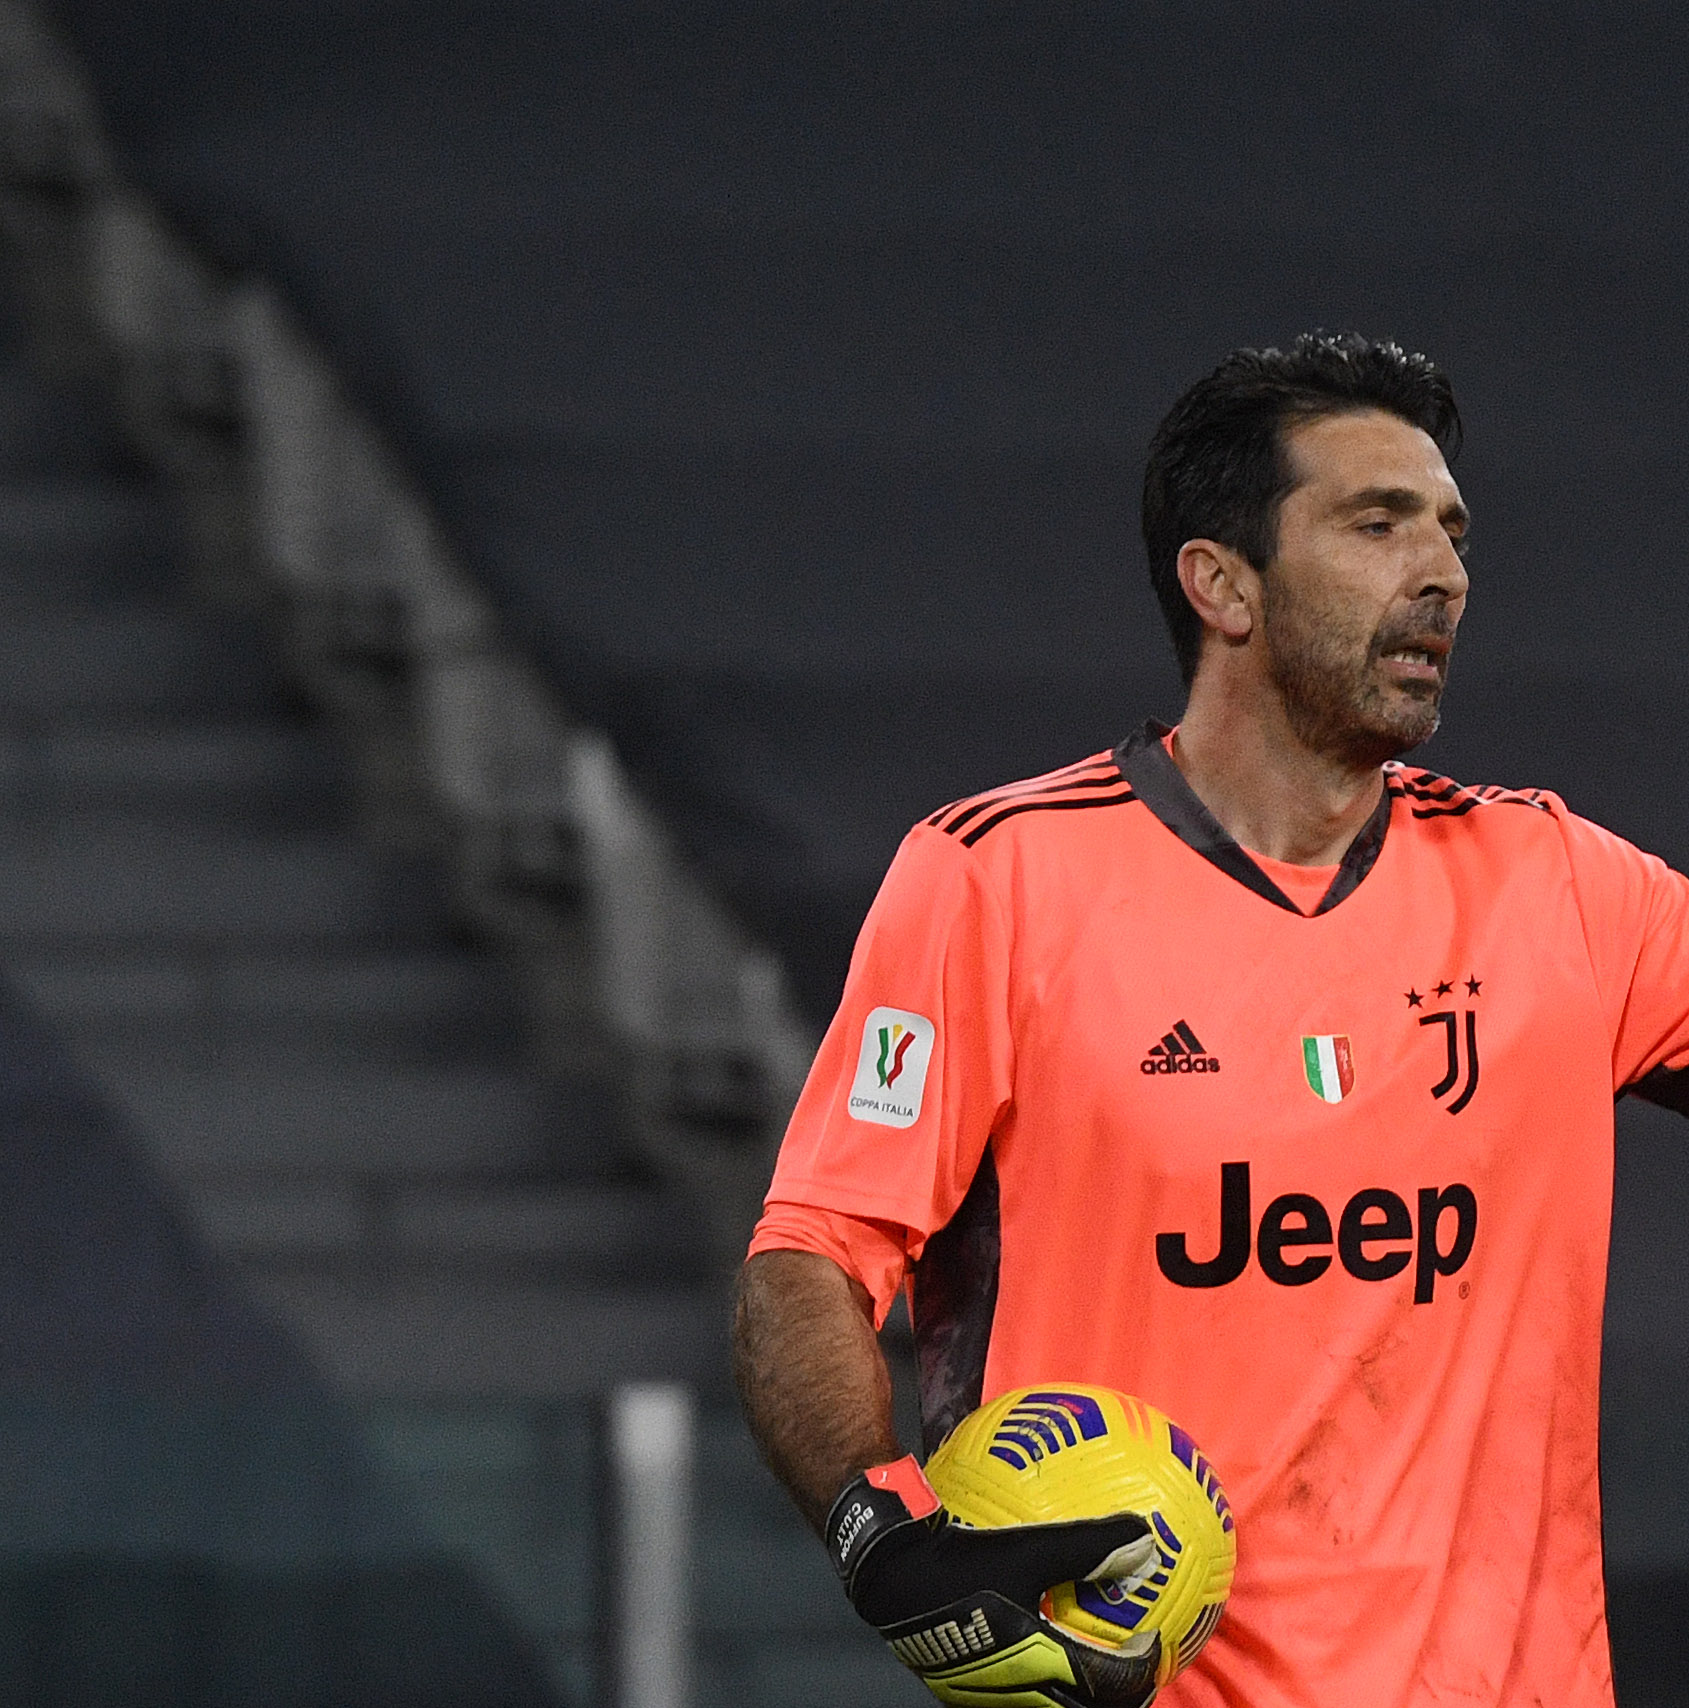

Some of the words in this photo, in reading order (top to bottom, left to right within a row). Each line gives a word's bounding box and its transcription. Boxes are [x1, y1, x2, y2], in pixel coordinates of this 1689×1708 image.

[1139, 1053, 1221, 1075] adidas
[849, 1096, 880, 1111] COPPA
[881, 1103, 914, 1118] ITALIA
[1155, 1161, 1478, 1305] Jeep
[840, 1505, 875, 1563] BUFFON
